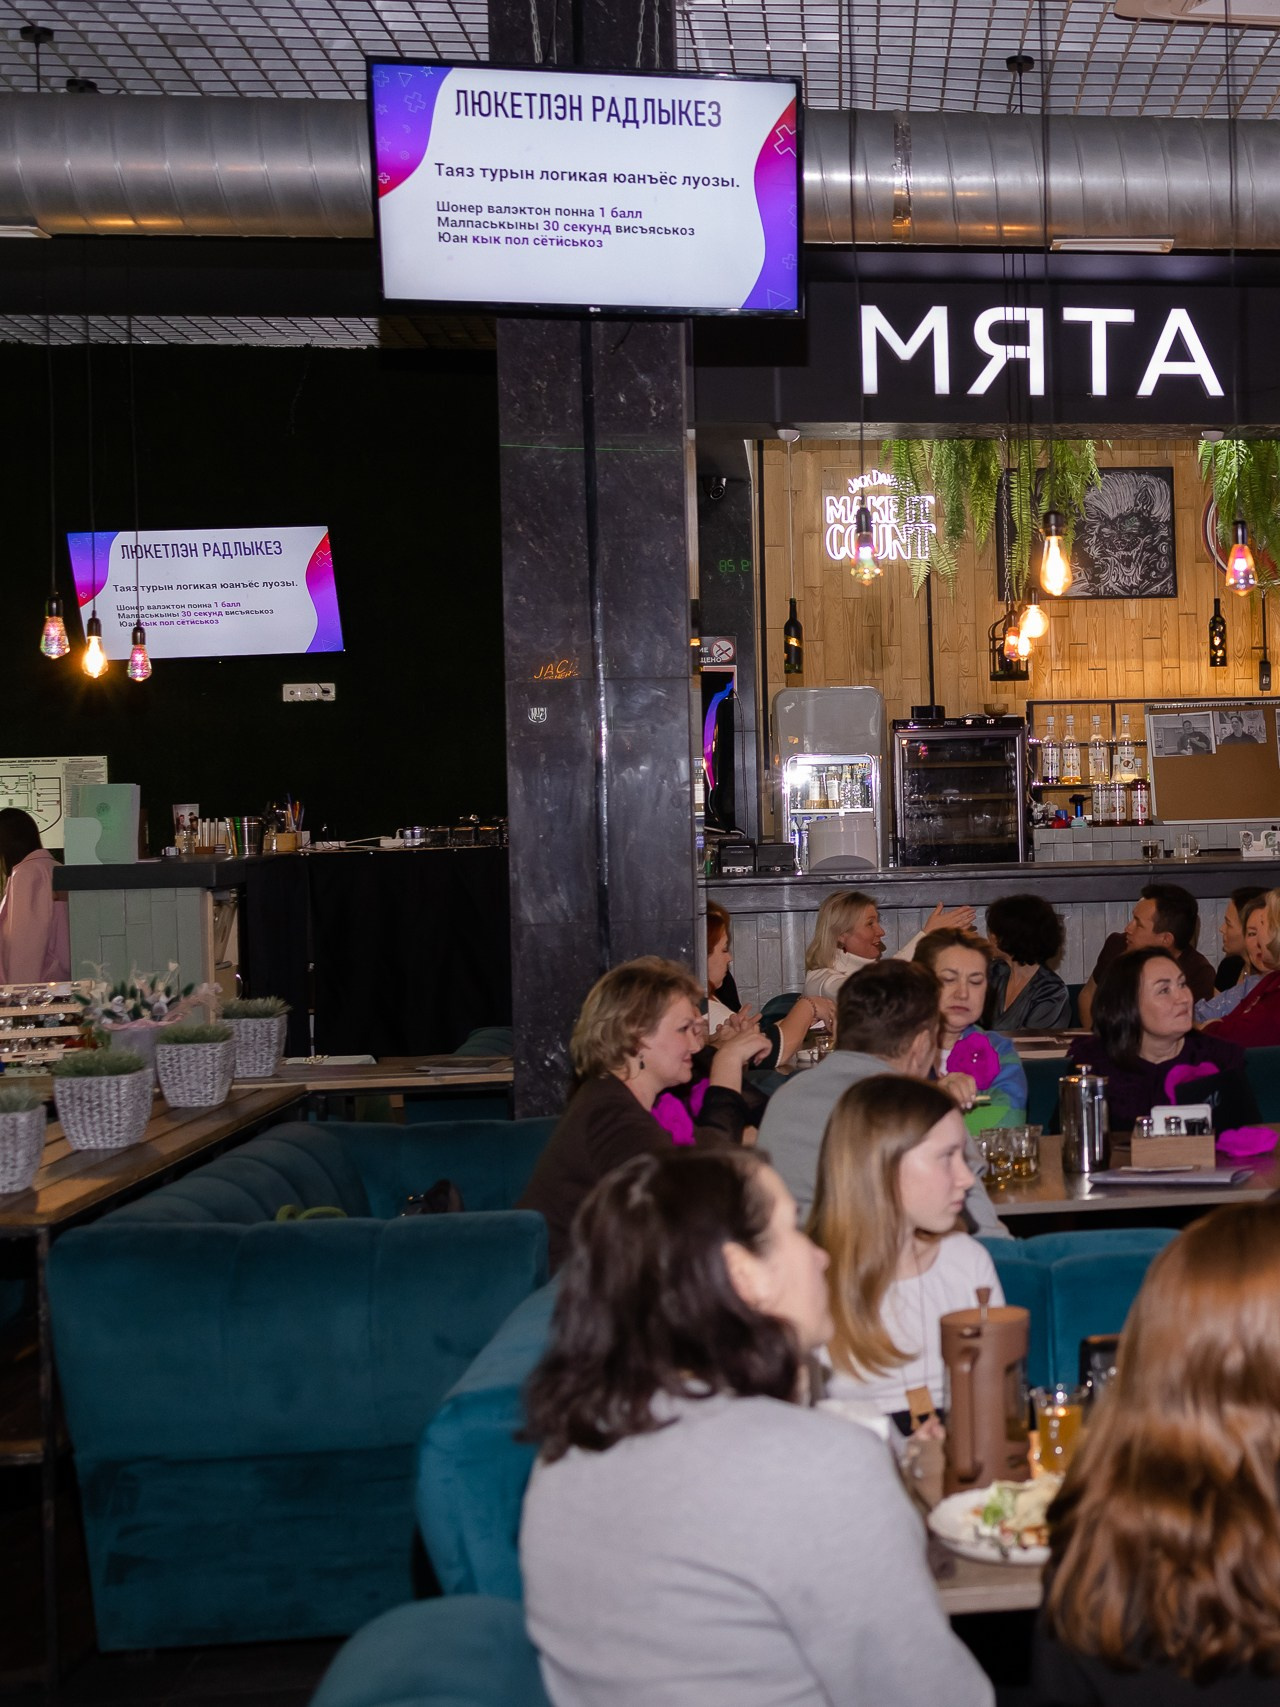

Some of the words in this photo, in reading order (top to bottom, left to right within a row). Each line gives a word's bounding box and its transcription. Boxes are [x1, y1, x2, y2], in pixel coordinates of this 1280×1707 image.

[455, 89, 583, 122] ЛЮКЕТЛЭН
[592, 96, 722, 128] РАДЛЫКЕЗ
[435, 162, 474, 178] Таяз
[480, 167, 534, 183] турын
[540, 170, 607, 183] логикая
[614, 171, 677, 186] юанъёс
[682, 175, 740, 190] луозы.
[437, 200, 483, 216] Шонер
[488, 205, 550, 216] валэктон
[555, 207, 594, 218] понна
[599, 206, 605, 218] 1
[611, 206, 642, 219] балл
[438, 216, 539, 231] Малпаськыны
[543, 219, 559, 232] 30
[564, 223, 611, 236] секунд
[615, 224, 695, 236] висъяськоз
[438, 231, 468, 244] Юан
[472, 235, 501, 245] кык
[505, 236, 529, 246] пол
[860, 304, 1225, 398] МЯТА
[121, 542, 198, 560] ЛЮКЕТЛЭН
[203, 541, 282, 559] РАДЛЫКЕЗ
[140, 583, 174, 593] турын
[176, 582, 217, 591] логикая
[220, 579, 260, 589] юанъёс
[261, 580, 299, 590] луозы.
